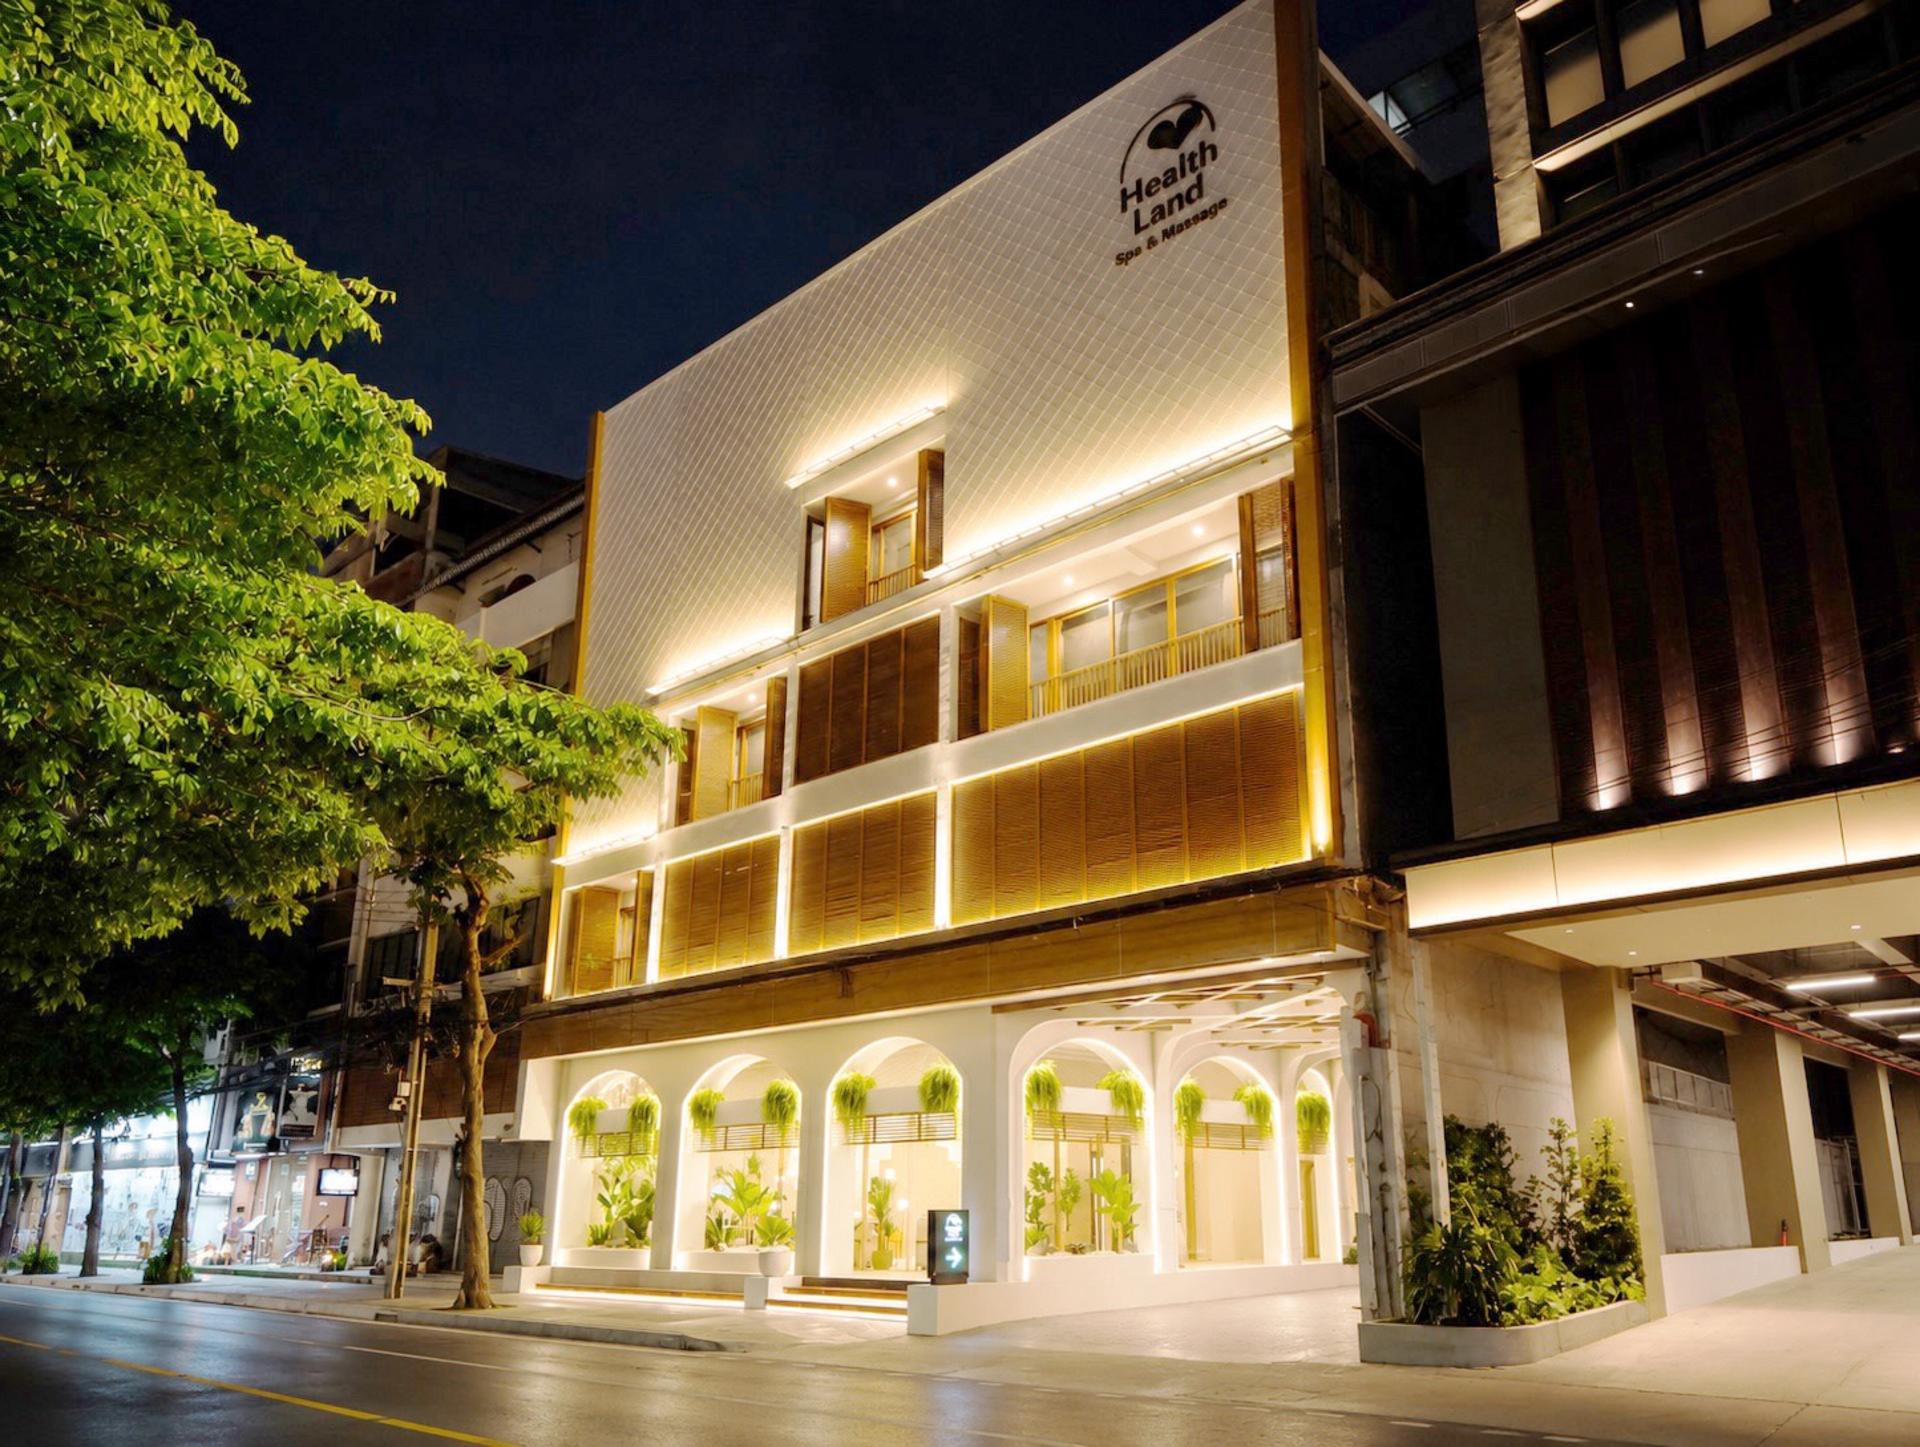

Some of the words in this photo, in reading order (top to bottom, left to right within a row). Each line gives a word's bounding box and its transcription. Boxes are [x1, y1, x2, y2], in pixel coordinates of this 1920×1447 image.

[1121, 140, 1217, 213] Health
[1134, 173, 1203, 235] Land
[1115, 246, 1142, 266] Spa
[1147, 235, 1158, 250] &
[1161, 198, 1228, 242] Massage
